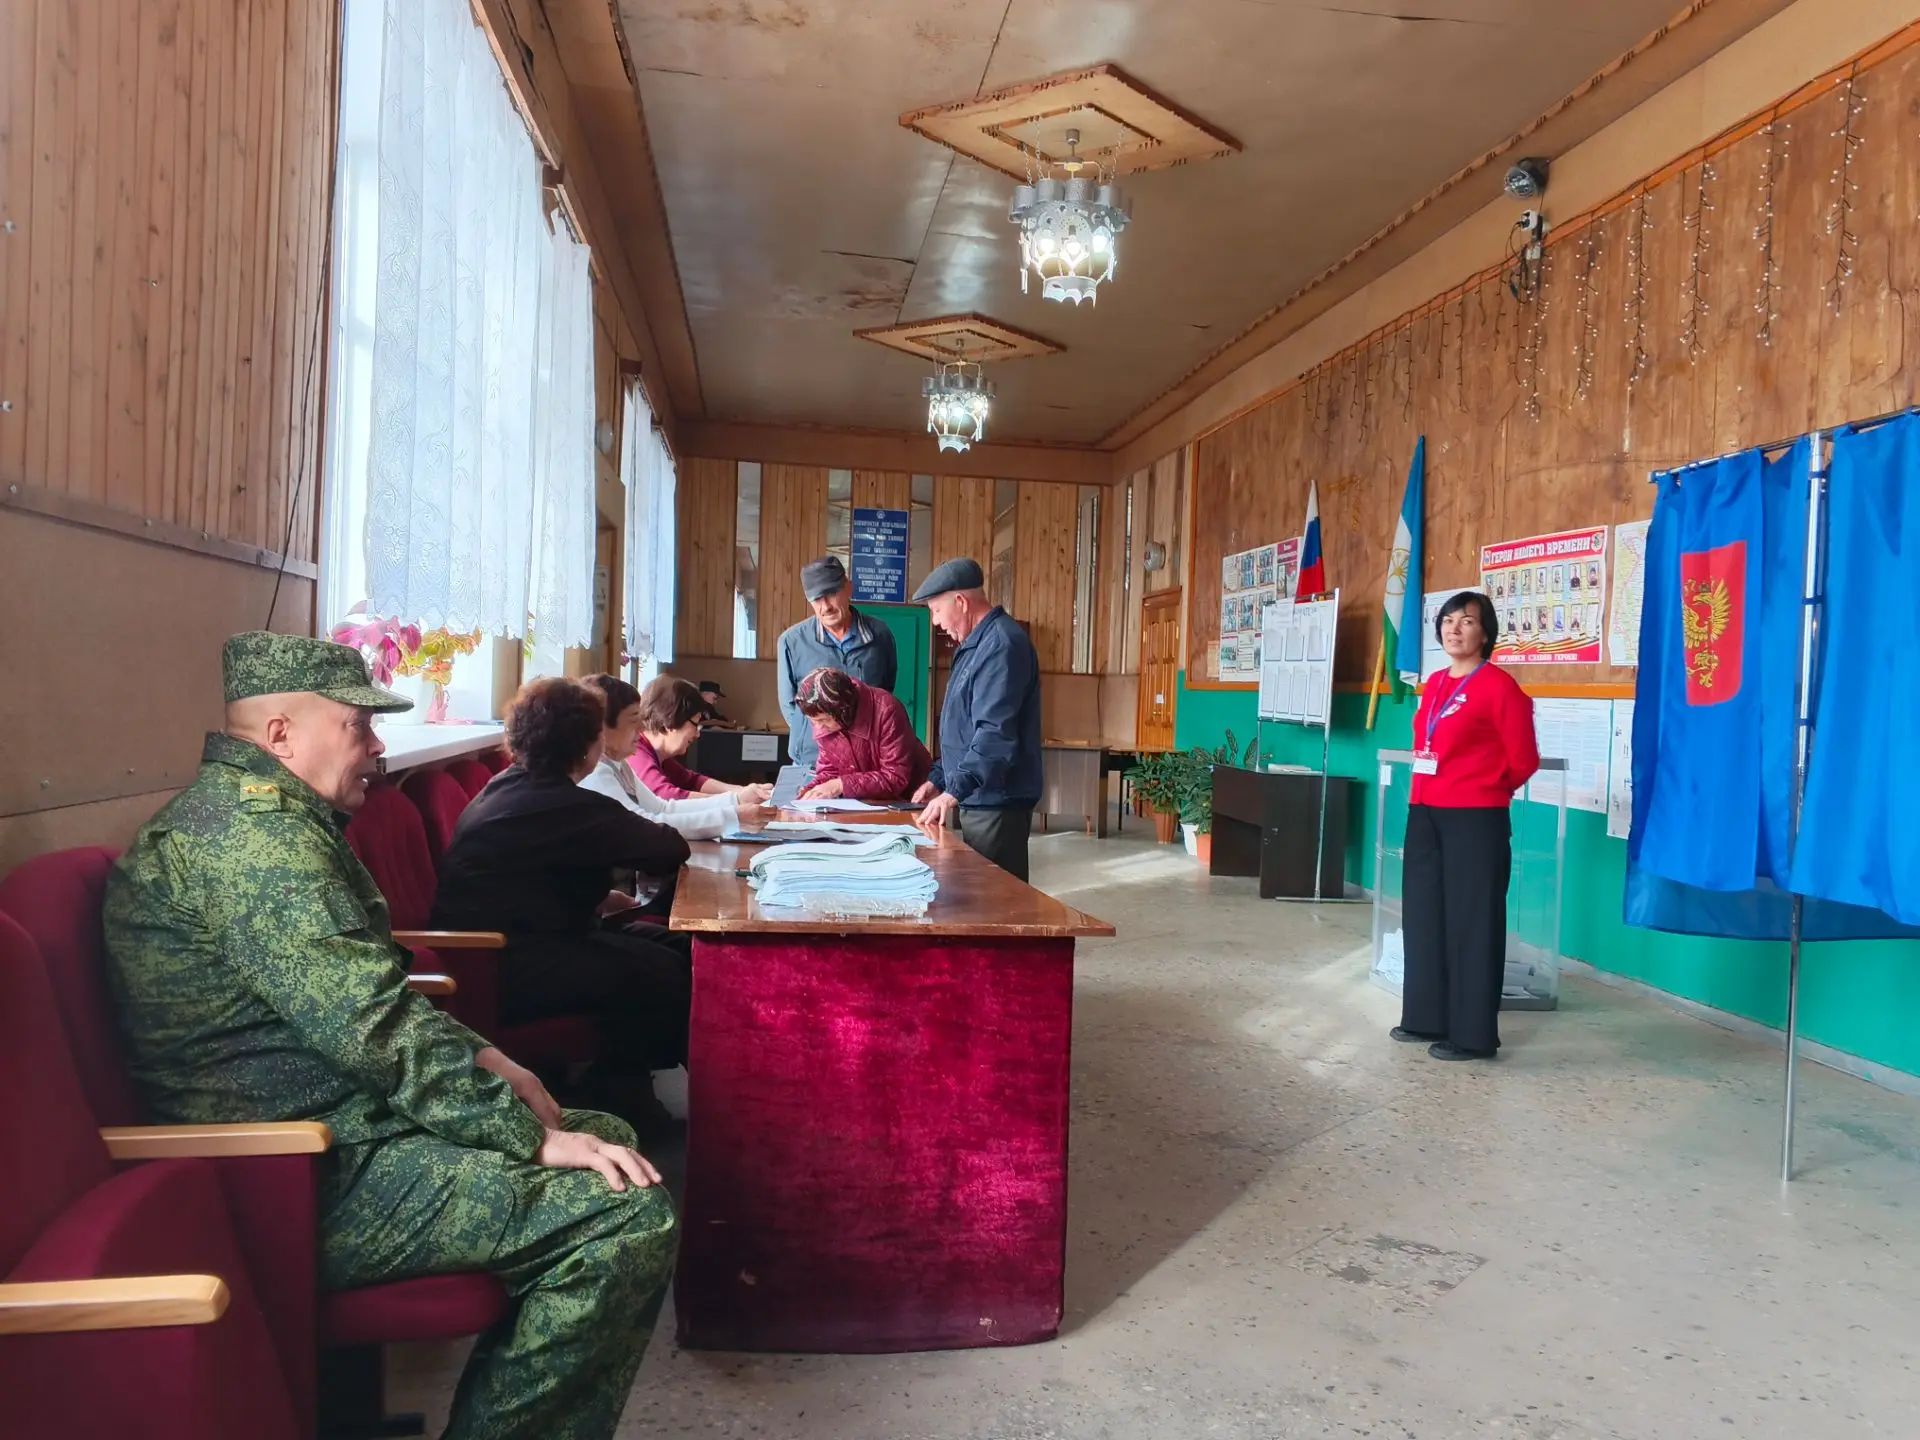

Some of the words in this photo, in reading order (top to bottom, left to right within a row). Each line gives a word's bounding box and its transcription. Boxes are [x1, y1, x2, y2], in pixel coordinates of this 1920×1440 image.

[1491, 549, 1514, 565] ГЕРОИ
[1514, 542, 1545, 560] НАШЕГО
[1546, 536, 1591, 555] ВРЕМЕНИ
